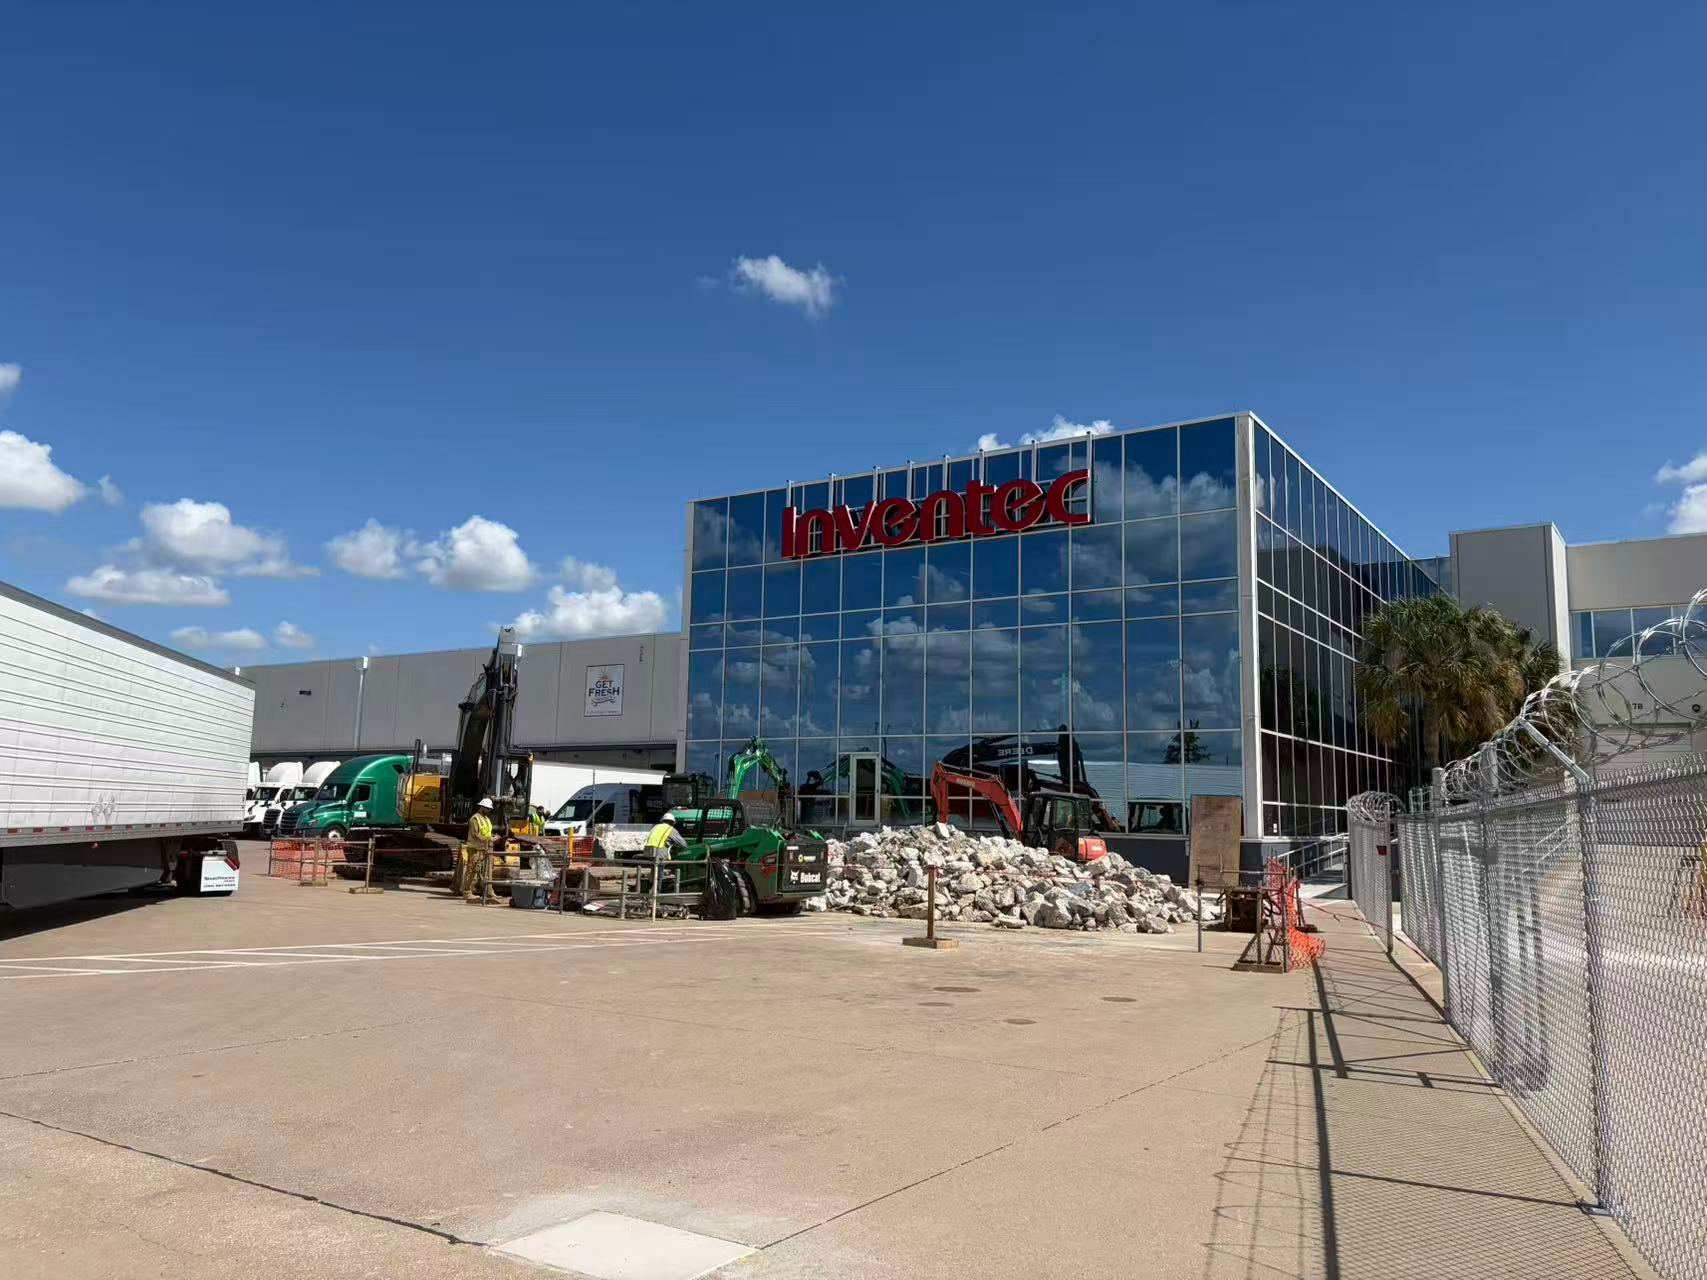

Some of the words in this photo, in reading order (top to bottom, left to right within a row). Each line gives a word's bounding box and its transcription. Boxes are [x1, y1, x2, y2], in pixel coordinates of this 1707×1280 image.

[781, 468, 1092, 559] Inventec
[595, 680, 614, 689] GET
[588, 686, 620, 697] FRESH
[800, 872, 821, 884] Bobcat
